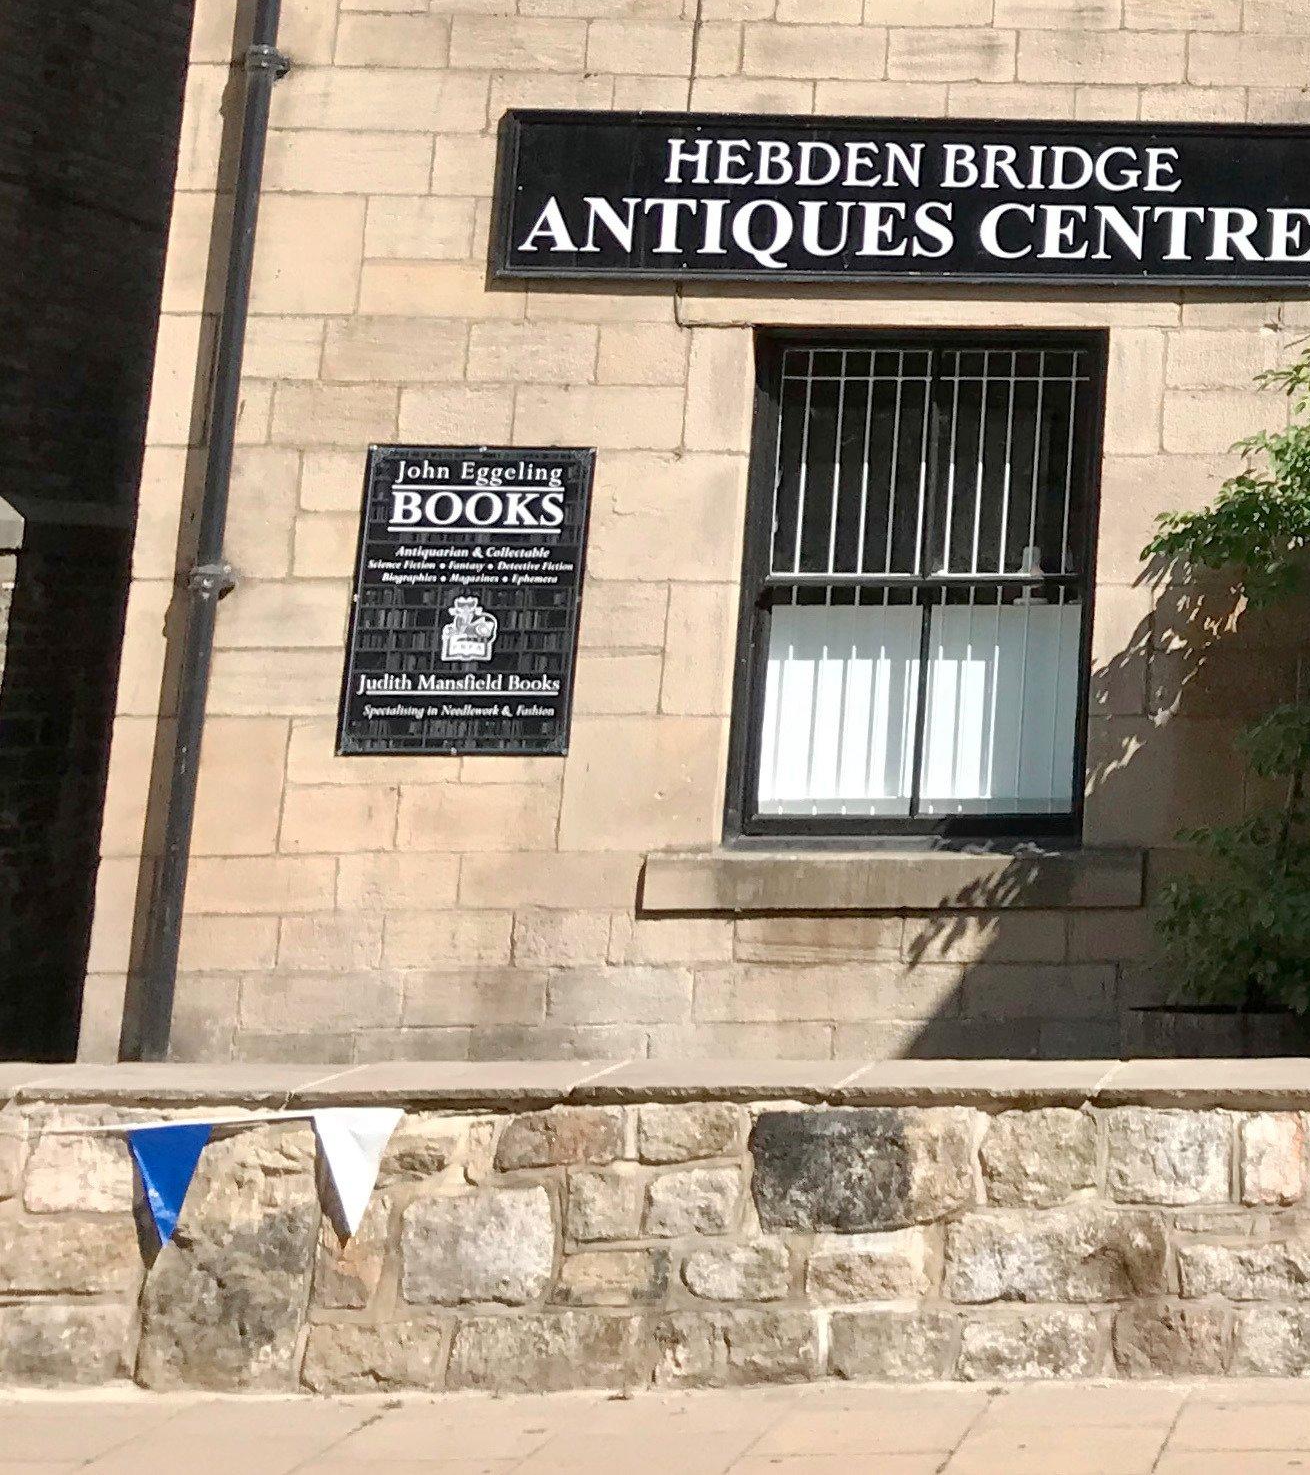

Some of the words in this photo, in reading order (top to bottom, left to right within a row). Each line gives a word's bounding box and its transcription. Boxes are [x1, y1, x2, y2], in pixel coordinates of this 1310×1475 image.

[666, 138, 923, 189] HEBDEN
[941, 143, 1183, 194] BRIDGE
[517, 196, 957, 269] ANTIQUES
[394, 459, 450, 484] John
[461, 460, 563, 488] Eggeling
[388, 490, 565, 527] BOOKS
[395, 545, 470, 561] Antiquarian
[472, 546, 485, 559] &
[486, 546, 551, 559] Collectable
[367, 559, 402, 570] Science
[403, 559, 436, 570] Fiction
[449, 560, 485, 572] Fantasy
[497, 561, 541, 571] Detective
[542, 561, 574, 571] Fiction
[381, 572, 437, 584] Biographies
[449, 573, 500, 585] Magazines
[512, 574, 559, 585] Ephemera
[356, 673, 412, 695] Judith
[417, 673, 503, 691] Mansfield
[508, 674, 561, 691] Books
[362, 704, 425, 719] Specialising
[427, 706, 438, 716] in
[440, 705, 500, 717] Needlework
[501, 705, 514, 717] &
[515, 705, 555, 717] Fashion
